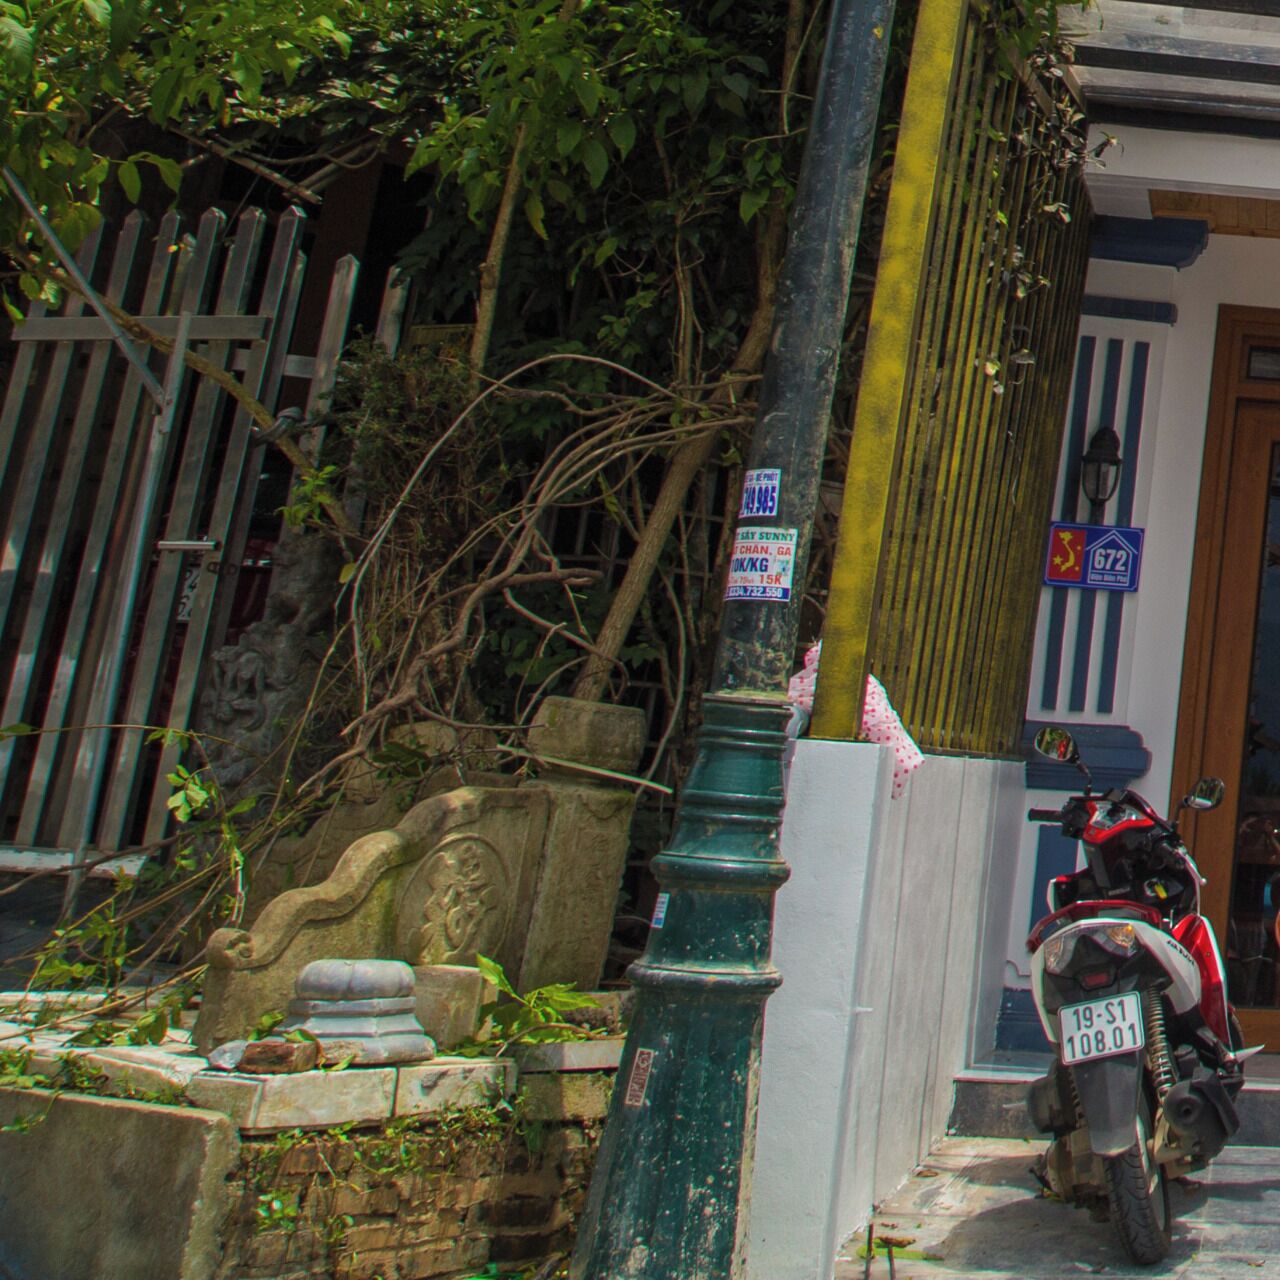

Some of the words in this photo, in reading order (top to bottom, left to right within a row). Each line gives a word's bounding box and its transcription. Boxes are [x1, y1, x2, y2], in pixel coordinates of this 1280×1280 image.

[758, 531, 795, 542] SUNNY
[777, 546, 791, 556] GA
[1094, 548, 1128, 571] 672
[759, 574, 782, 585] 15K
[1073, 999, 1127, 1031] 19-S1
[1067, 1023, 1138, 1059] 108.01
